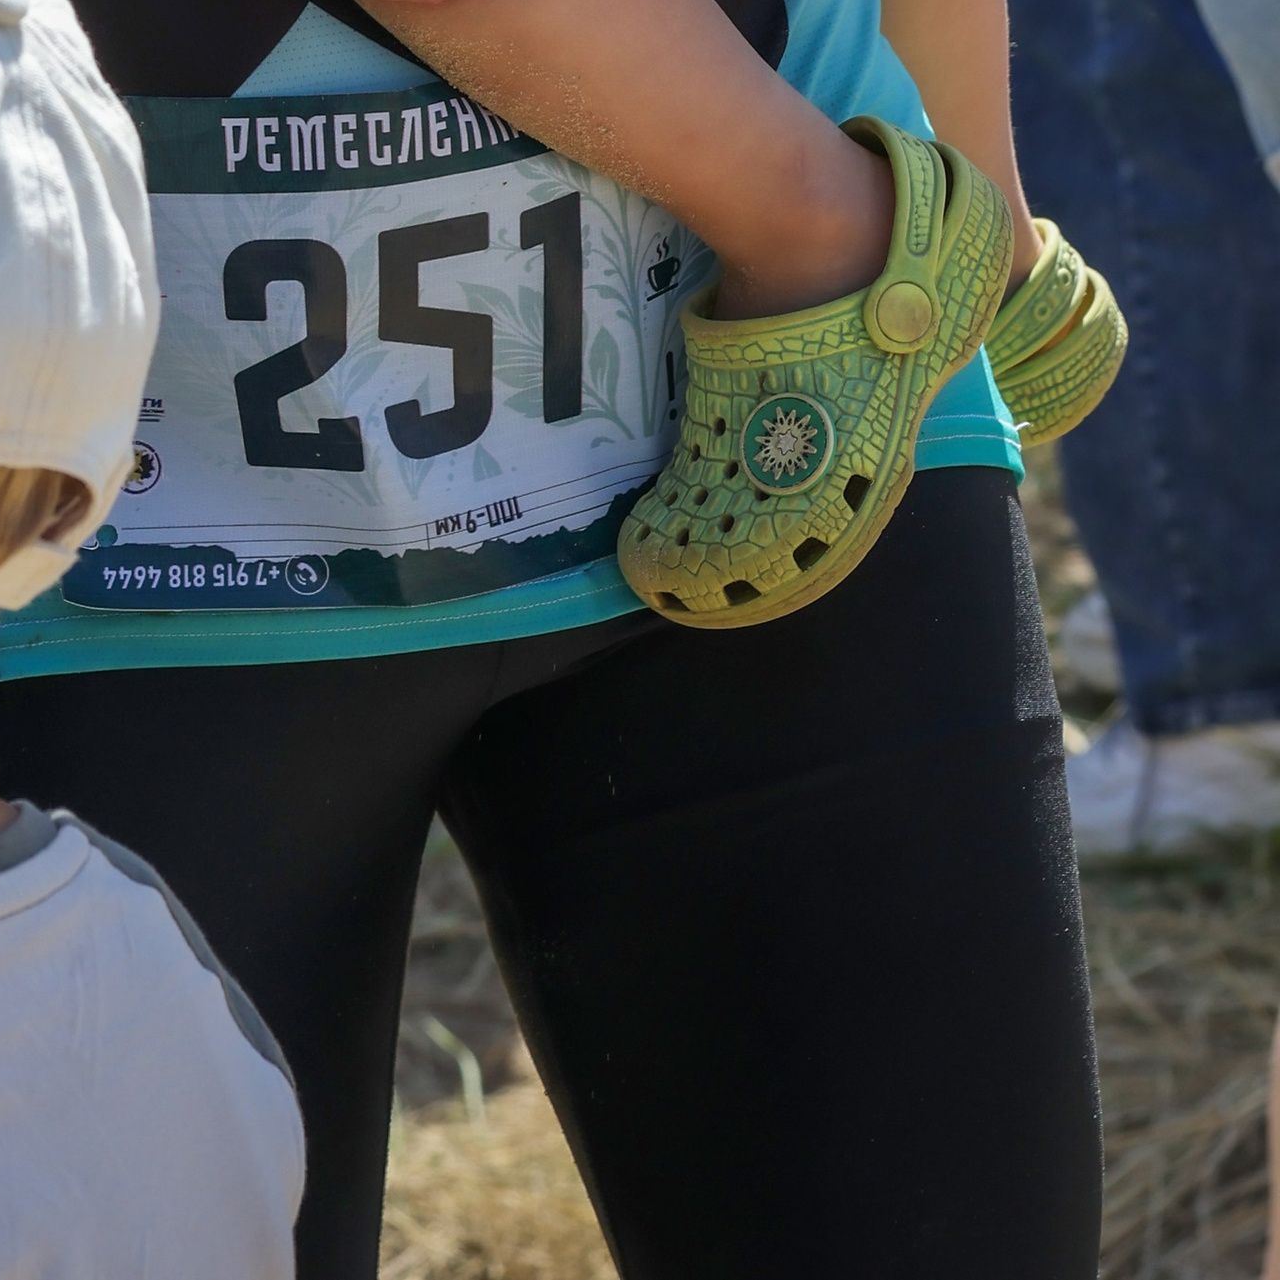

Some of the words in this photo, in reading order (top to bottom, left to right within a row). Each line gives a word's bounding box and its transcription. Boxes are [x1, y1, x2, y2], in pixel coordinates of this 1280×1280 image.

[220, 96, 520, 174] РЕМЕСЛЕНН
[223, 191, 583, 473] 251
[102, 564, 162, 590] 4644
[168, 564, 206, 588] 818
[212, 562, 249, 588] 915
[255, 562, 281, 587] +7
